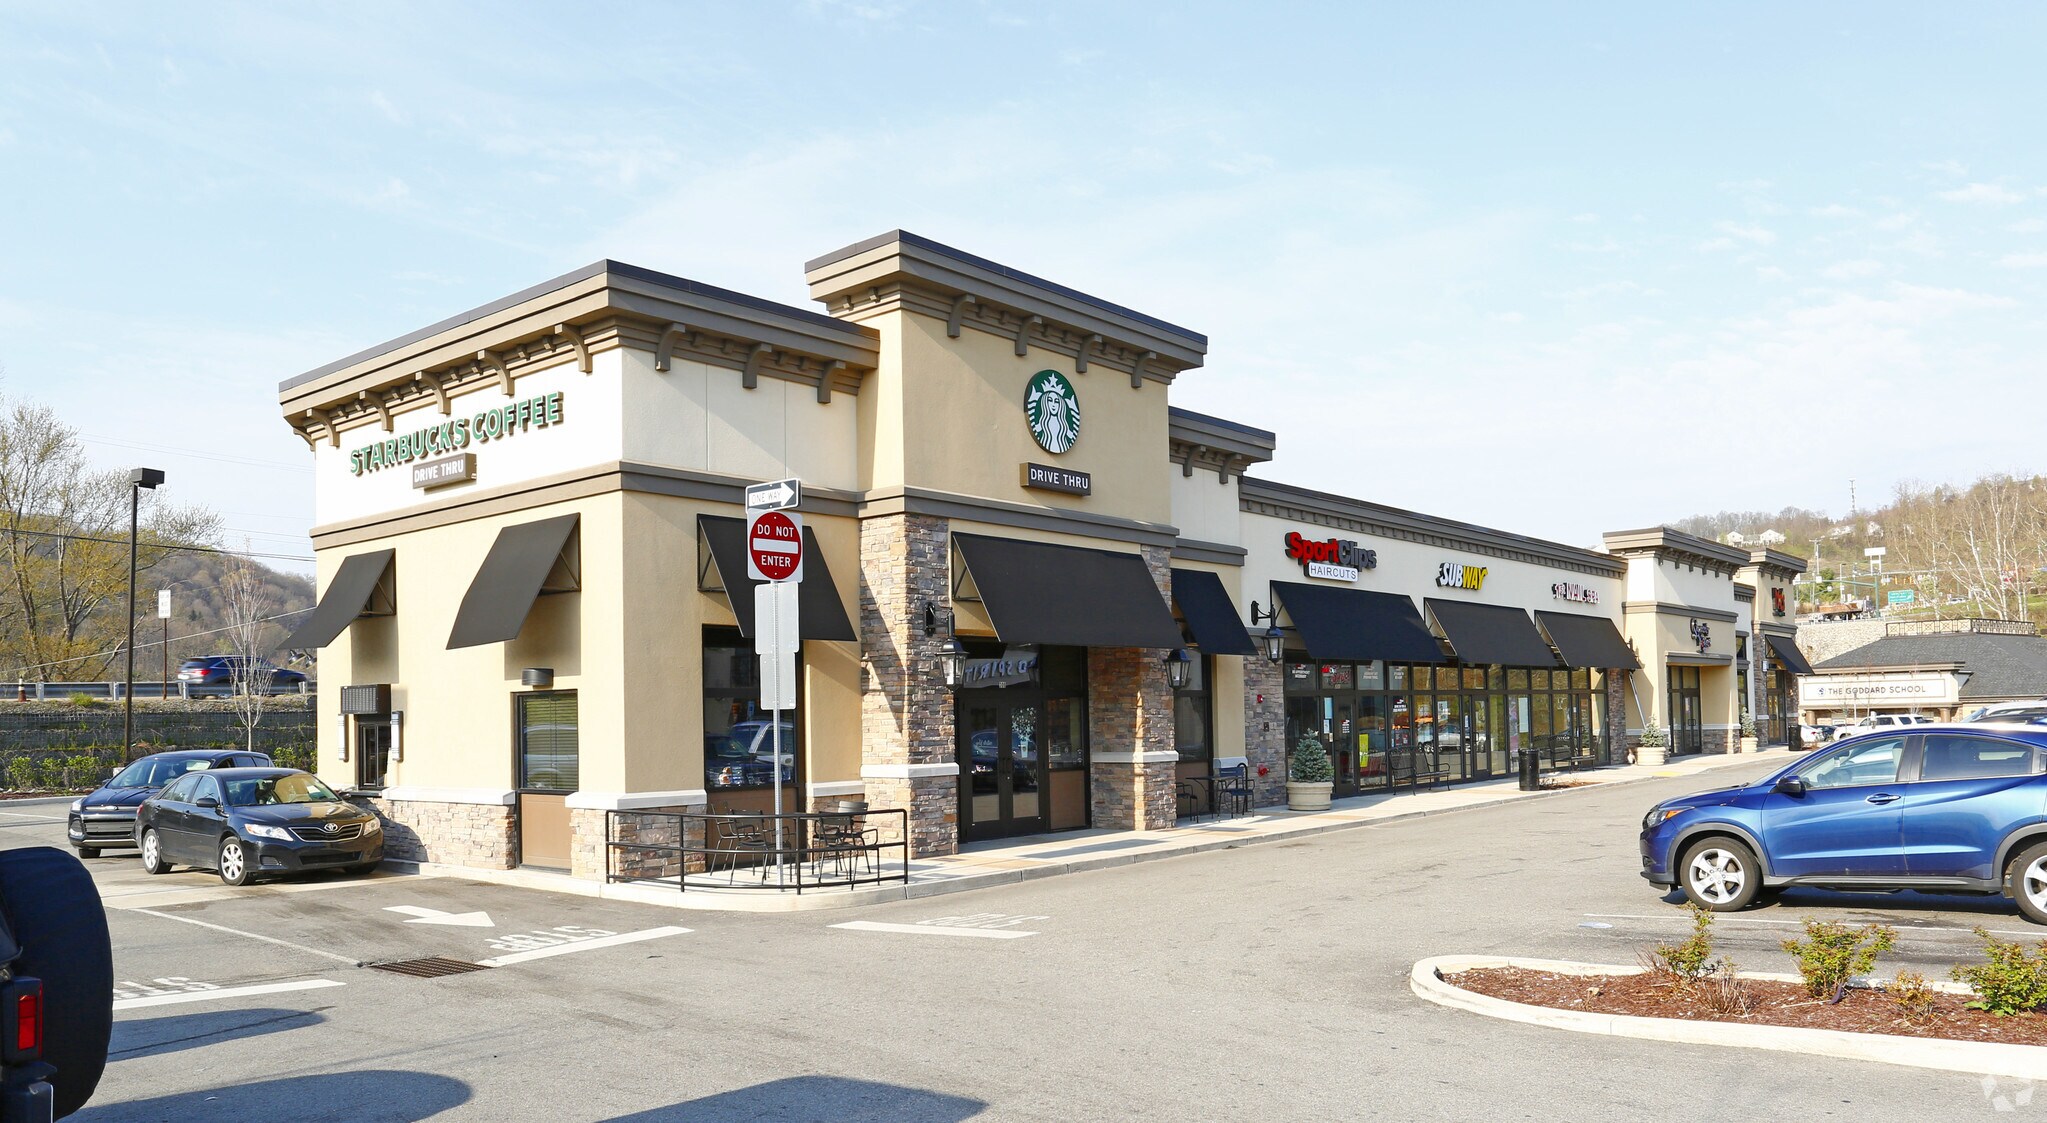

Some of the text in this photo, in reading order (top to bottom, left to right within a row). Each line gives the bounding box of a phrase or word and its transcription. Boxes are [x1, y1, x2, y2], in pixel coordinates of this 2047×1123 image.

[350, 392, 561, 475] STARBUCKS COFFEE
[413, 458, 465, 483] DRIVE THRU
[1030, 468, 1089, 490] DRIVE THRU
[751, 489, 782, 505] ONE WAY
[757, 523, 794, 538] DO NOT
[761, 554, 792, 568] ENTER
[1310, 564, 1357, 580] HAIRCUTS
[1438, 562, 1489, 590] SUBWAY
[1828, 685, 1926, 695] THE GODDARD SCHOOL
[484, 925, 618, 952] STOP
